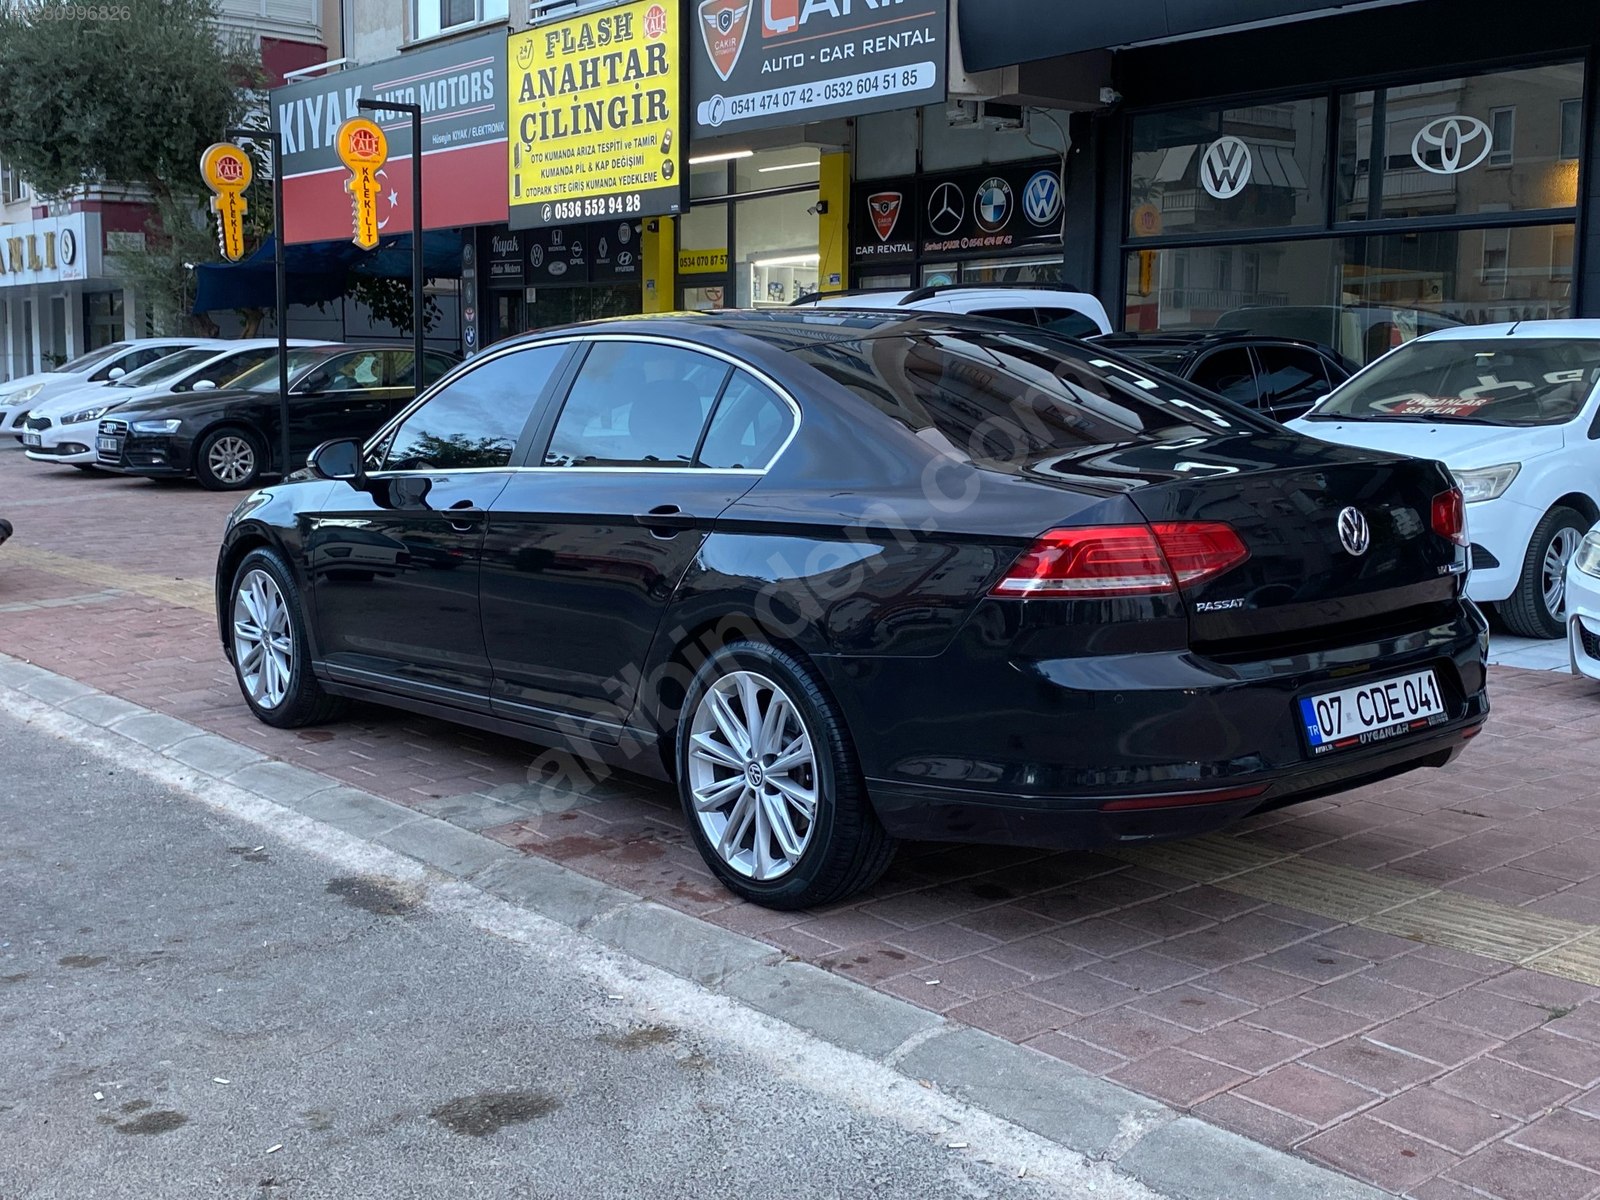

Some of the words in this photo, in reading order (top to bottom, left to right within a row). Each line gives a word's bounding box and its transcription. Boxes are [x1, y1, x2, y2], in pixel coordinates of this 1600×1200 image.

[545, 12, 634, 59] FLASH
[761, 54, 804, 74] AUTO
[820, 43, 855, 63] CAR
[862, 28, 936, 55] RENTAL
[518, 42, 669, 103] ANAHTAR
[420, 68, 494, 113] MOTORS
[731, 99, 756, 115] 0541
[759, 95, 779, 111] 474
[782, 92, 796, 107] 07
[799, 88, 813, 104] 42
[824, 81, 853, 99] 0532
[856, 77, 879, 94] 604
[882, 73, 897, 90] 51
[902, 69, 917, 86] 85
[520, 83, 670, 152] ÇİLİNGİR
[349, 135, 380, 154] KALE
[452, 128, 468, 140] KIYAK
[531, 153, 543, 164] OTO
[544, 148, 575, 162] KUMANDA
[577, 144, 596, 157] ARIZA
[624, 141, 632, 150] ve
[216, 163, 243, 179] KALE
[540, 165, 574, 179] KUMANDA
[575, 161, 586, 174] PİL
[588, 161, 593, 172] &
[595, 159, 610, 172] KAP
[525, 186, 552, 198] OTOPARK
[586, 177, 617, 190] KUMANDA
[619, 171, 658, 186] YEDEKLEME
[555, 201, 582, 219] 0536
[584, 198, 605, 216] 552
[608, 196, 623, 214] 94
[625, 194, 641, 212] 28
[0, 231, 57, 275] NLI
[680, 257, 695, 267] 0534
[697, 255, 709, 266] 070
[710, 254, 718, 265] 87
[720, 254, 728, 264] 57
[855, 245, 874, 255] CAR
[877, 243, 913, 254] RENTAL
[1196, 598, 1245, 613] PASSAT
[1316, 696, 1342, 737] 07
[1357, 682, 1405, 727] CDE
[1404, 674, 1441, 715] 041
[1308, 724, 1319, 737] TR
[1360, 723, 1410, 744] UYGANLAR
